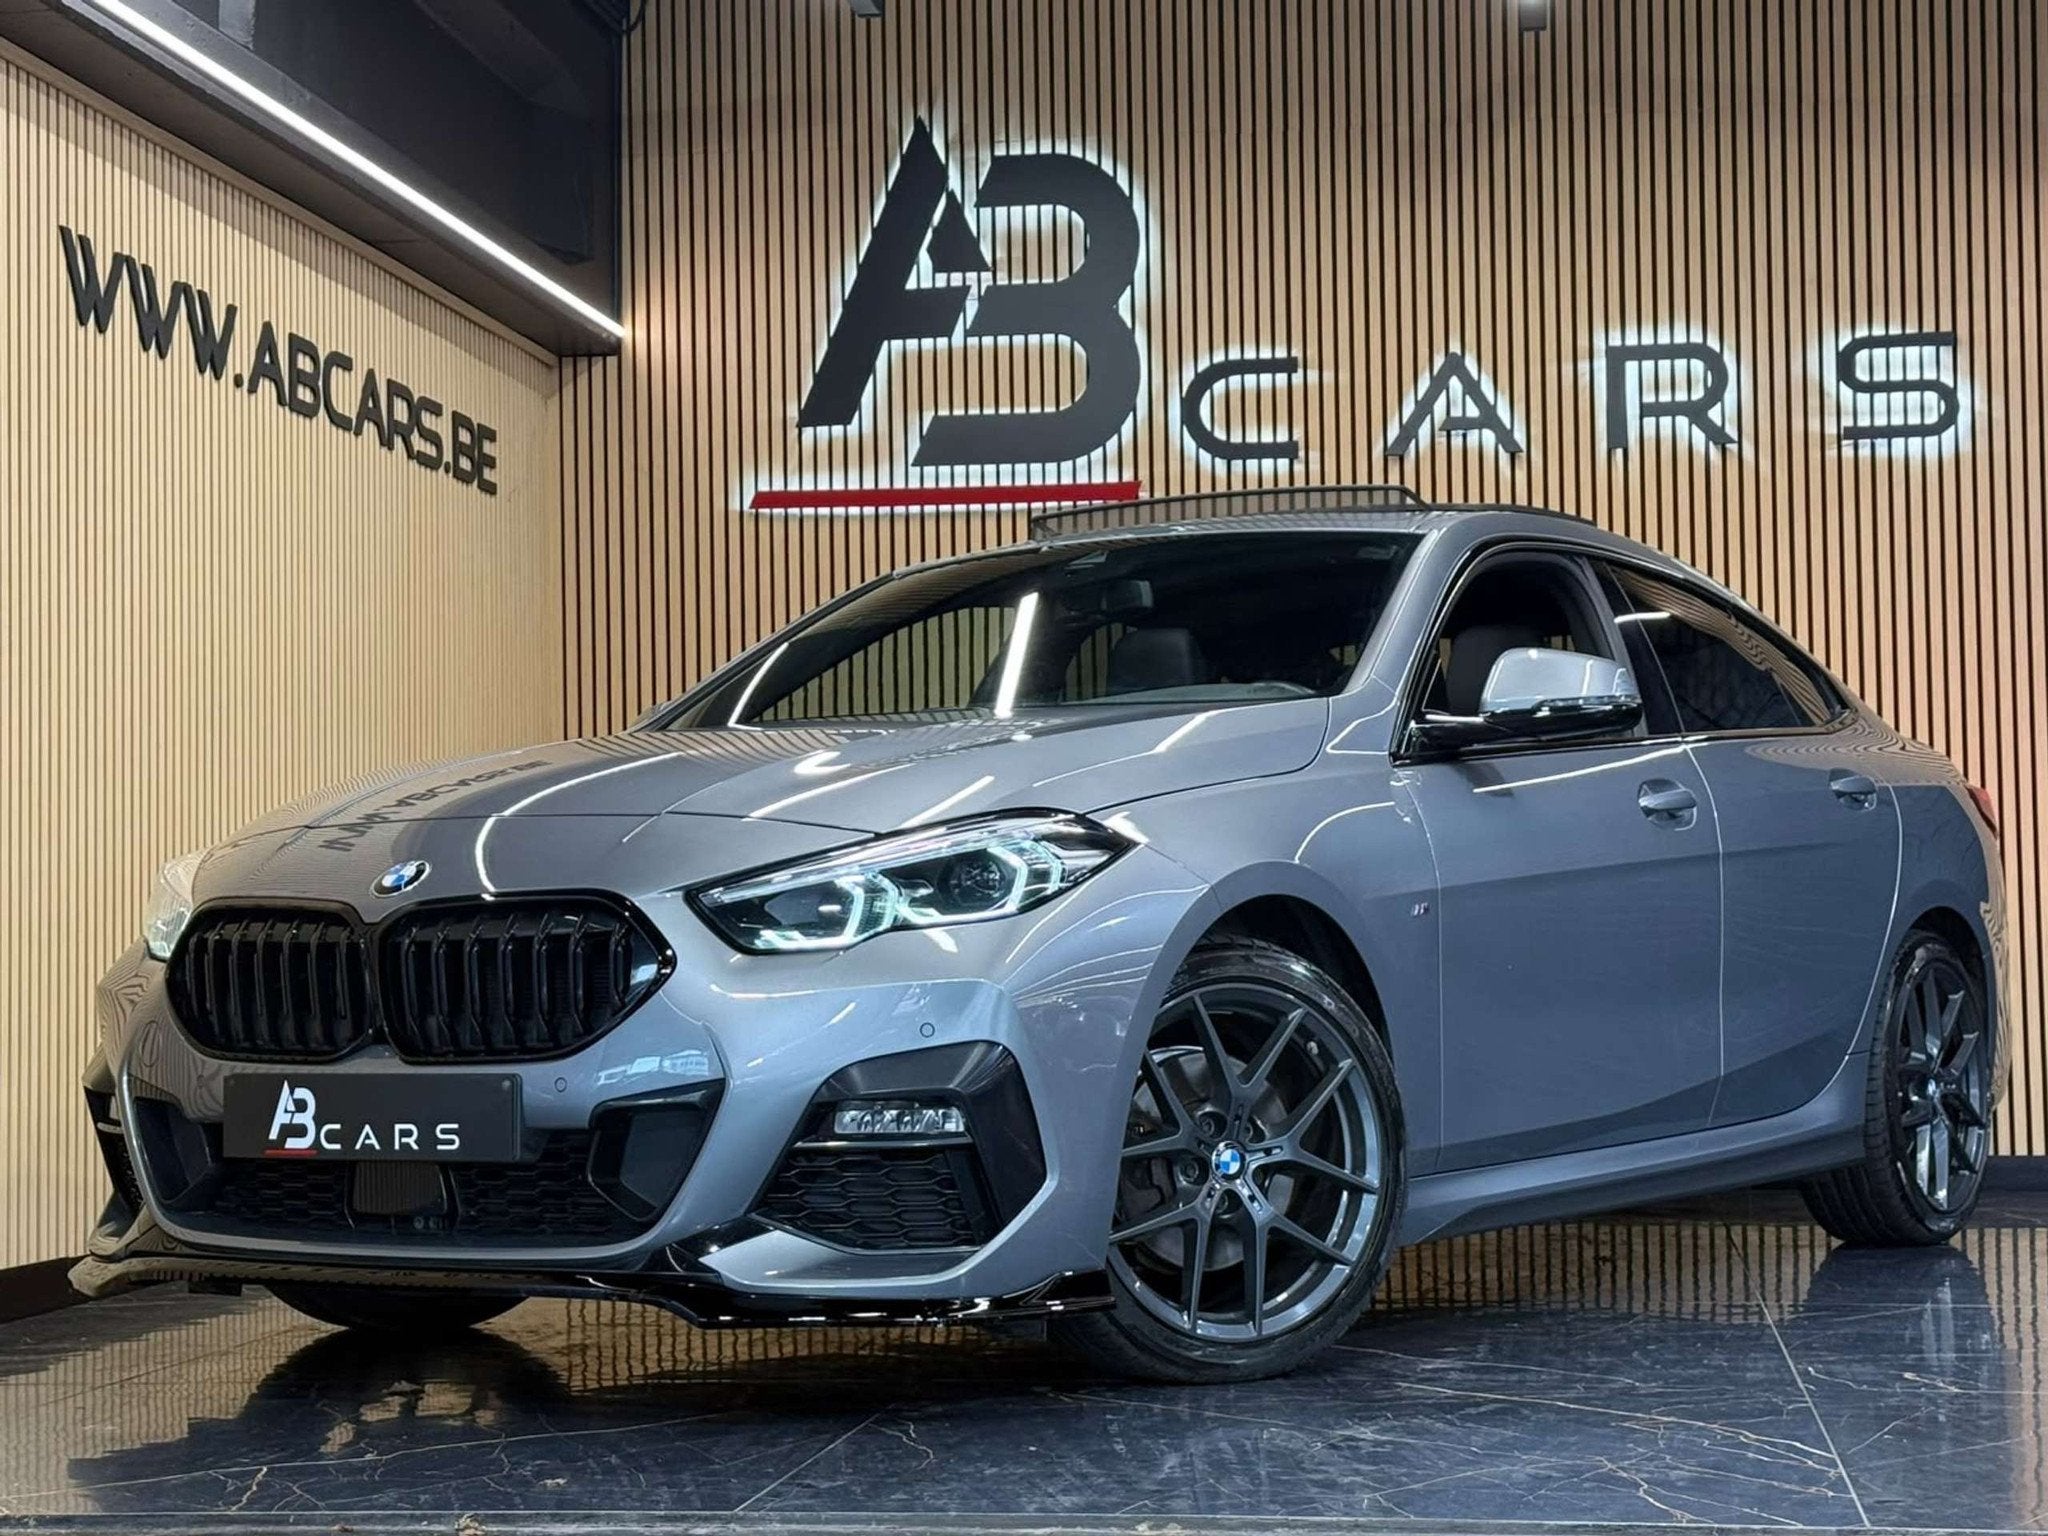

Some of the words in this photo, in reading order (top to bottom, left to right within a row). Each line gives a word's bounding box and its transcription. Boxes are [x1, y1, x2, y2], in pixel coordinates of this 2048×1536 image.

[58, 225, 498, 496] WWW.ABCARS.BE
[795, 115, 1141, 467] AB
[1181, 330, 1960, 460] CARS
[268, 1080, 316, 1149] AB
[319, 1123, 460, 1150] CARS
